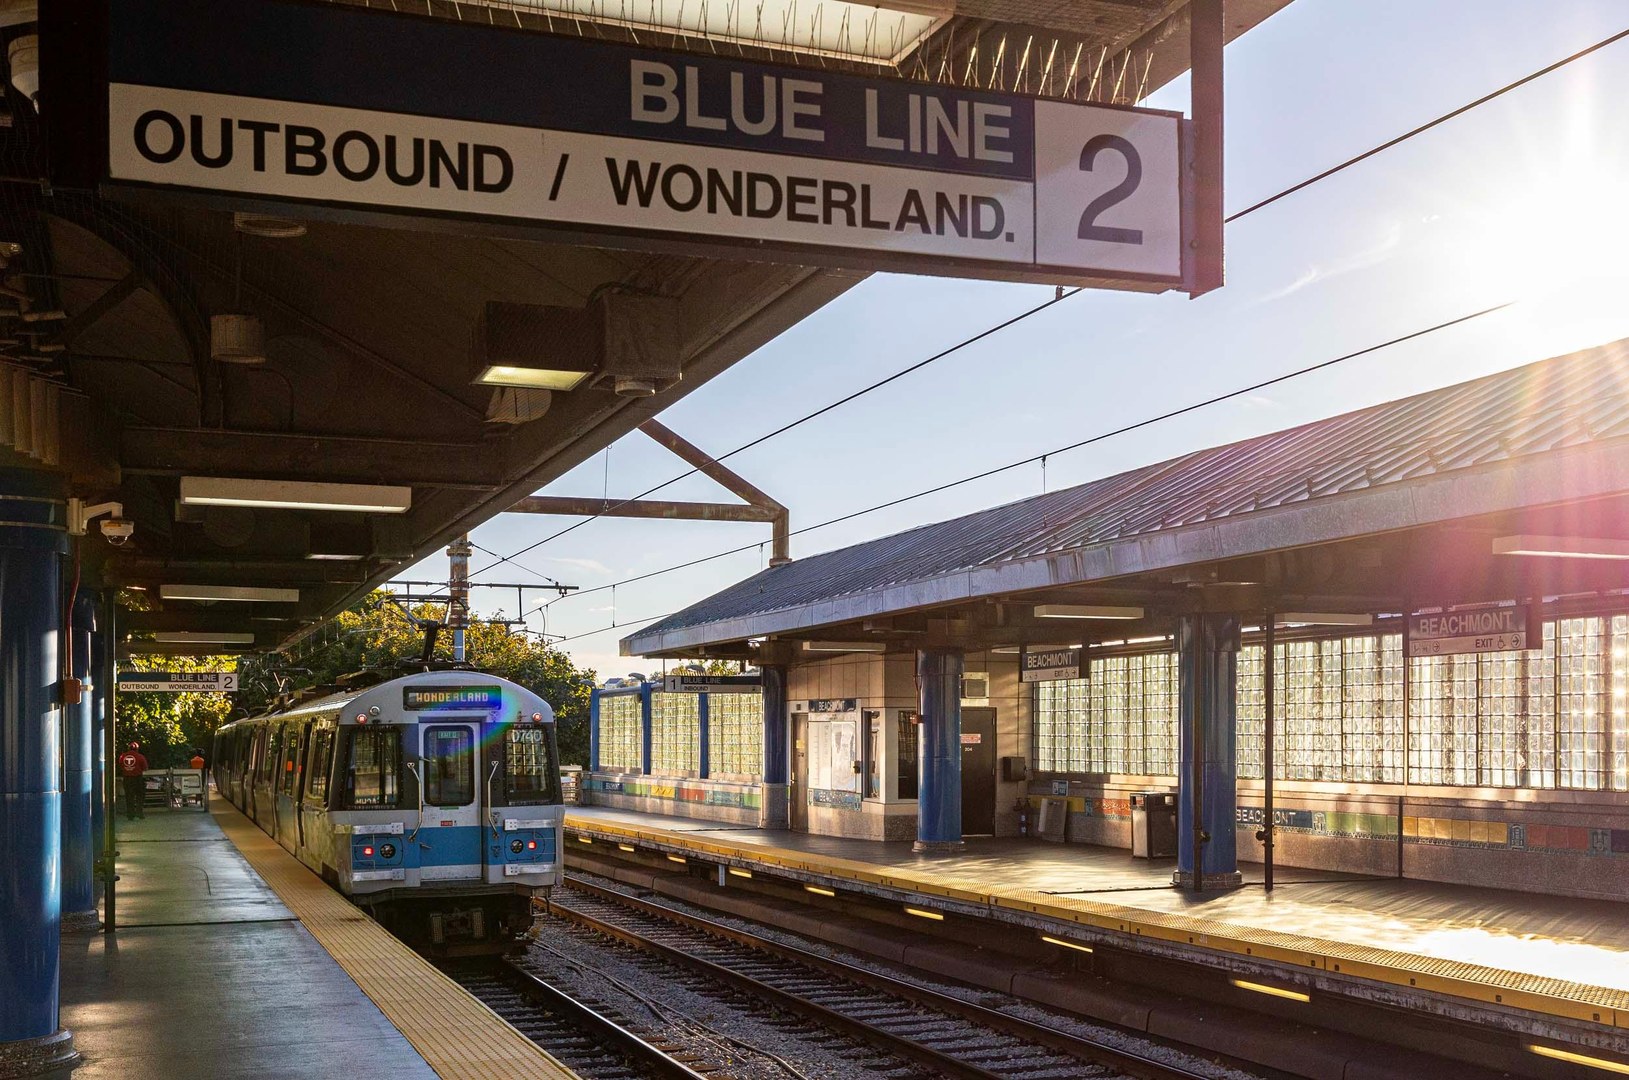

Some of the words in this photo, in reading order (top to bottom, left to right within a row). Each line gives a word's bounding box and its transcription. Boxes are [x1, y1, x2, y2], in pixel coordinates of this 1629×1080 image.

[630, 59, 824, 142] BLUE
[865, 88, 1014, 163] LINE
[133, 110, 514, 193] OUTBOUND
[548, 154, 569, 201] /
[605, 158, 1014, 242] WONDERLAND.
[1077, 134, 1143, 245] 2
[1420, 611, 1513, 634] BEACHMONT
[1475, 639, 1493, 648] EXIT
[1027, 652, 1073, 668] BEACHMONT
[223, 676, 233, 689] 2
[671, 678, 676, 690] 1
[416, 692, 489, 702] WONDERLAND
[1236, 808, 1296, 827] BEACHONT
